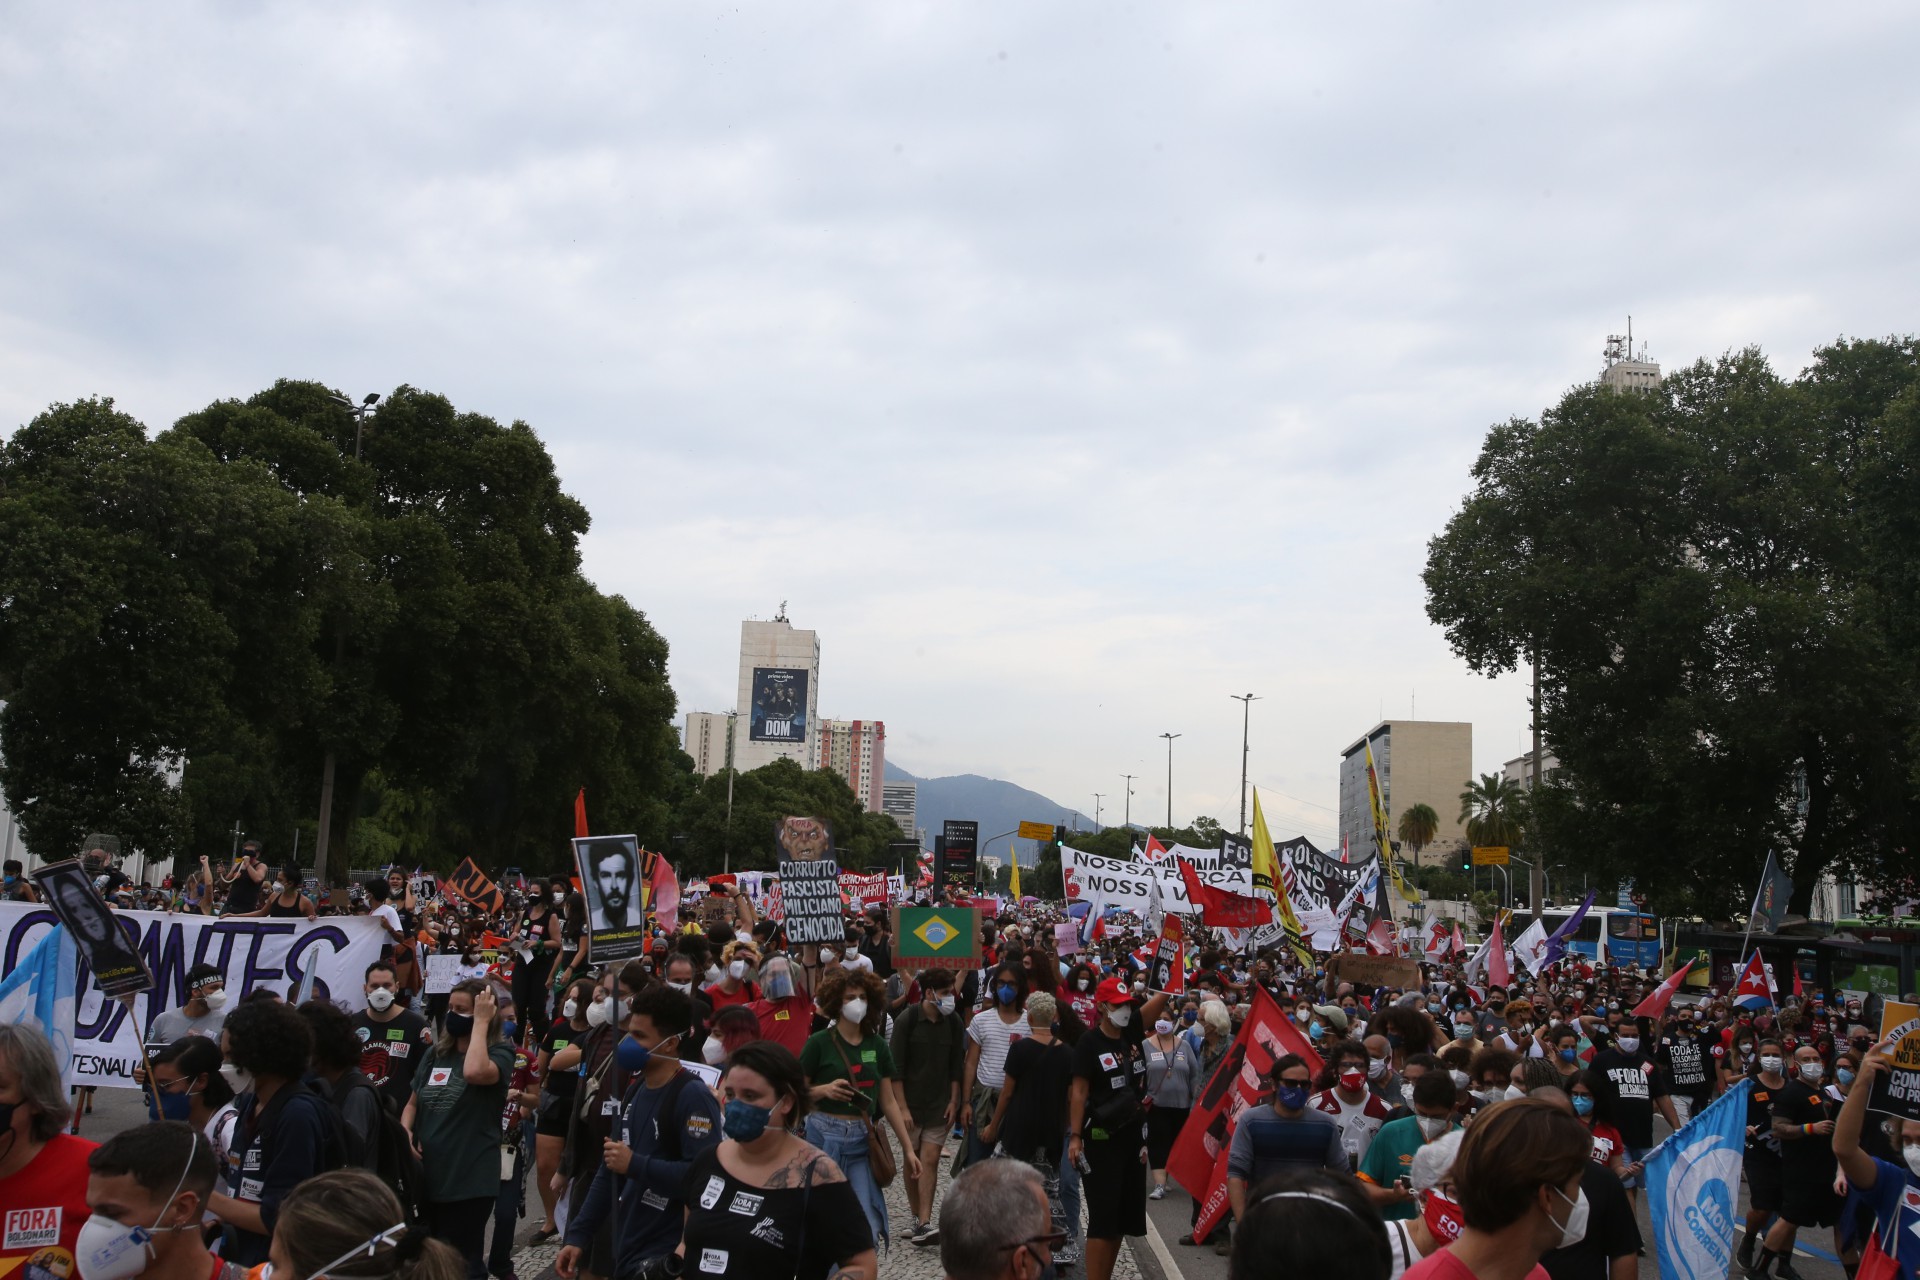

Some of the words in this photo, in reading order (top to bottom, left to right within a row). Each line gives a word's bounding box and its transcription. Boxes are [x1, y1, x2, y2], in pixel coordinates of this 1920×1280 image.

[765, 720, 790, 736] DOM
[780, 860, 837, 878] CORRUPTO
[1074, 851, 1158, 878] NOSSA
[452, 862, 498, 914] RUA
[781, 880, 840, 897] FASCISTA
[784, 897, 842, 916] MILICIANO
[786, 916, 846, 943] GENOCIDA
[892, 957, 982, 968] ANTIFASCISTA
[1670, 1044, 1700, 1056] FODA-SE
[1896, 1050, 1909, 1064] NO
[1616, 1068, 1648, 1084] FORA
[1888, 1084, 1905, 1099] NO
[9, 1209, 56, 1232] FORA
[8, 1230, 56, 1242] BOLSONARO
